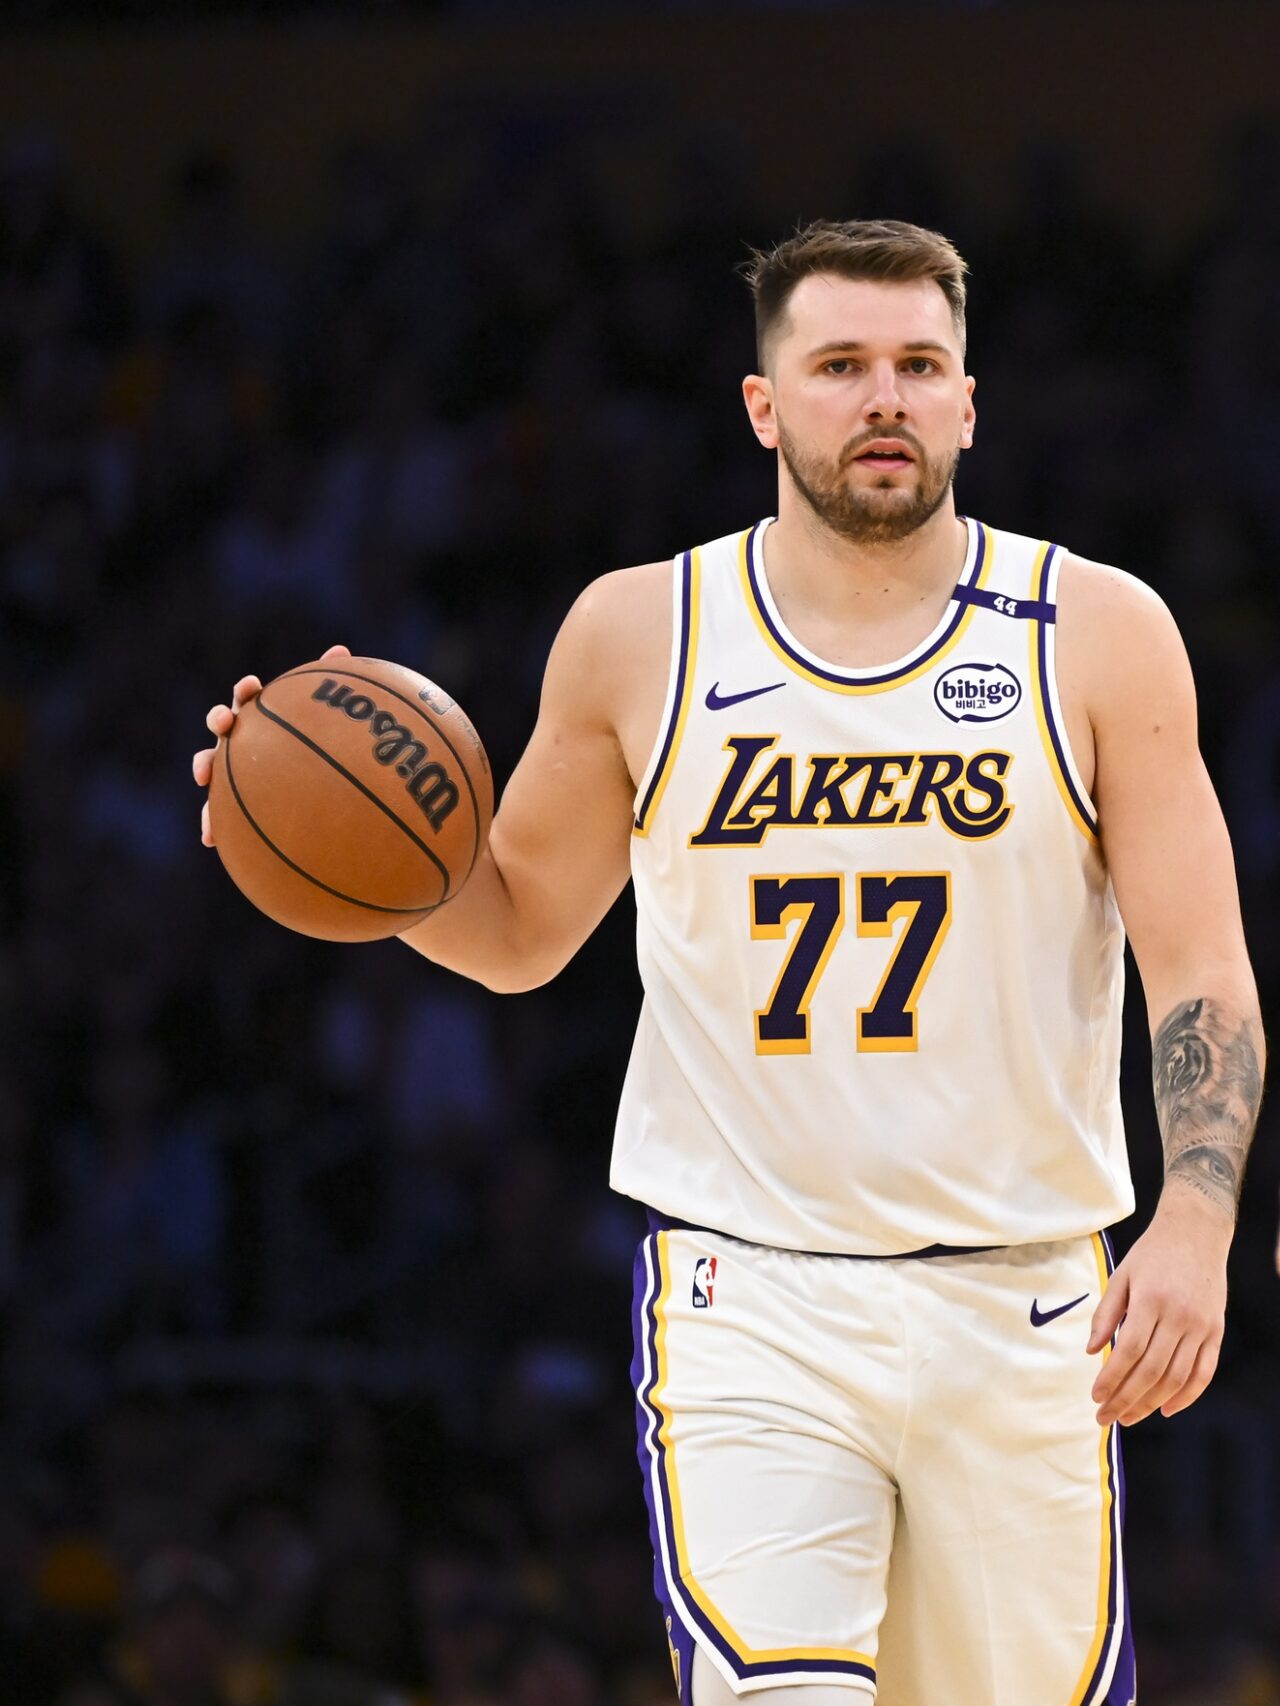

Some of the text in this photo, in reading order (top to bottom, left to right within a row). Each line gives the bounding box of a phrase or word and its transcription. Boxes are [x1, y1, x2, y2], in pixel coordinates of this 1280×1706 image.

[993, 595, 1017, 616] 44
[943, 679, 1016, 704] bibigo
[955, 700, 986, 710] 비비고
[312, 678, 460, 834] Wilson
[687, 733, 1015, 849] LAKERS
[749, 870, 952, 1056] 77
